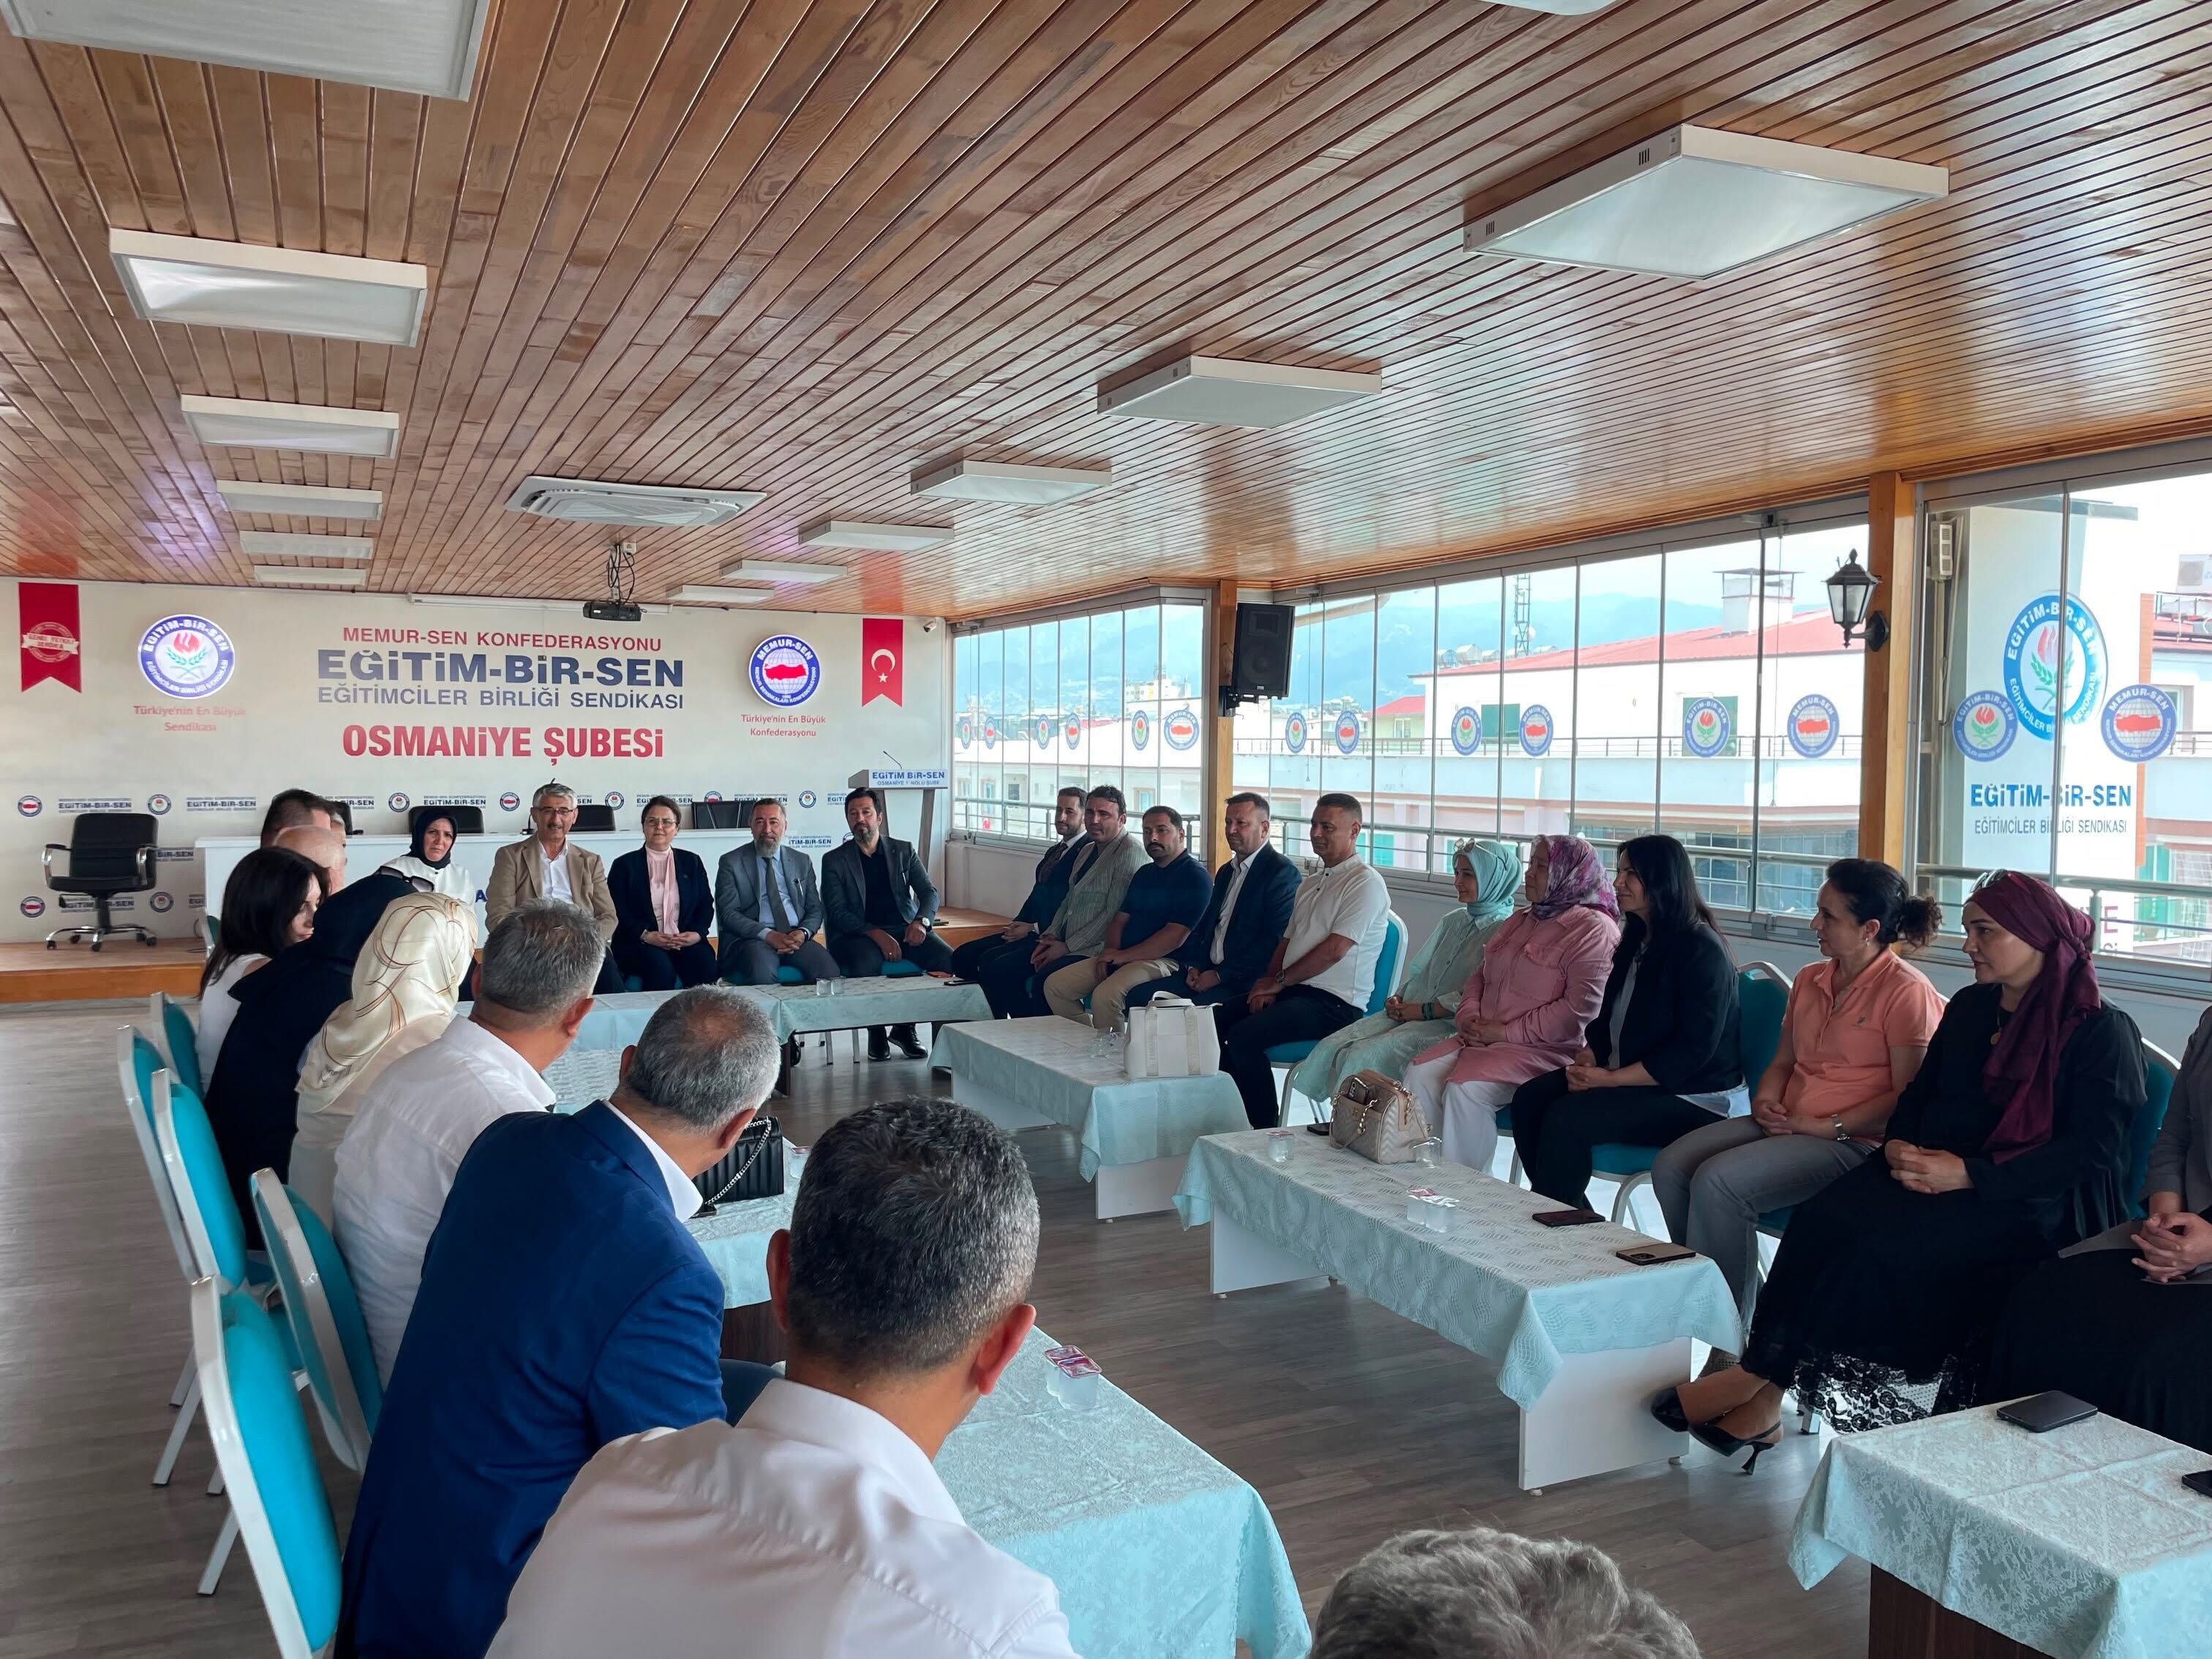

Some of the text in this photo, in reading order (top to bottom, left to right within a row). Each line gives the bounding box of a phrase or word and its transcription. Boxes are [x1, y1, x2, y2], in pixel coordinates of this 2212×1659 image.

[344, 628, 661, 651] MEMUR-SEN KONFEDERASYONU
[757, 639, 813, 661] MEMUR-SEN
[318, 683, 683, 709] EĞİTİMCİLER BİRLİĞİ SENDİKASI
[2109, 688, 2169, 711] MEMUR-SEN
[741, 715, 786, 724] Türkiye'nin
[801, 716, 826, 724] Büyük
[750, 728, 816, 737] Konfederasyonu
[1975, 816, 2036, 834] EĞİTİMCİLER
[2078, 816, 2126, 833] SENDİKASI
